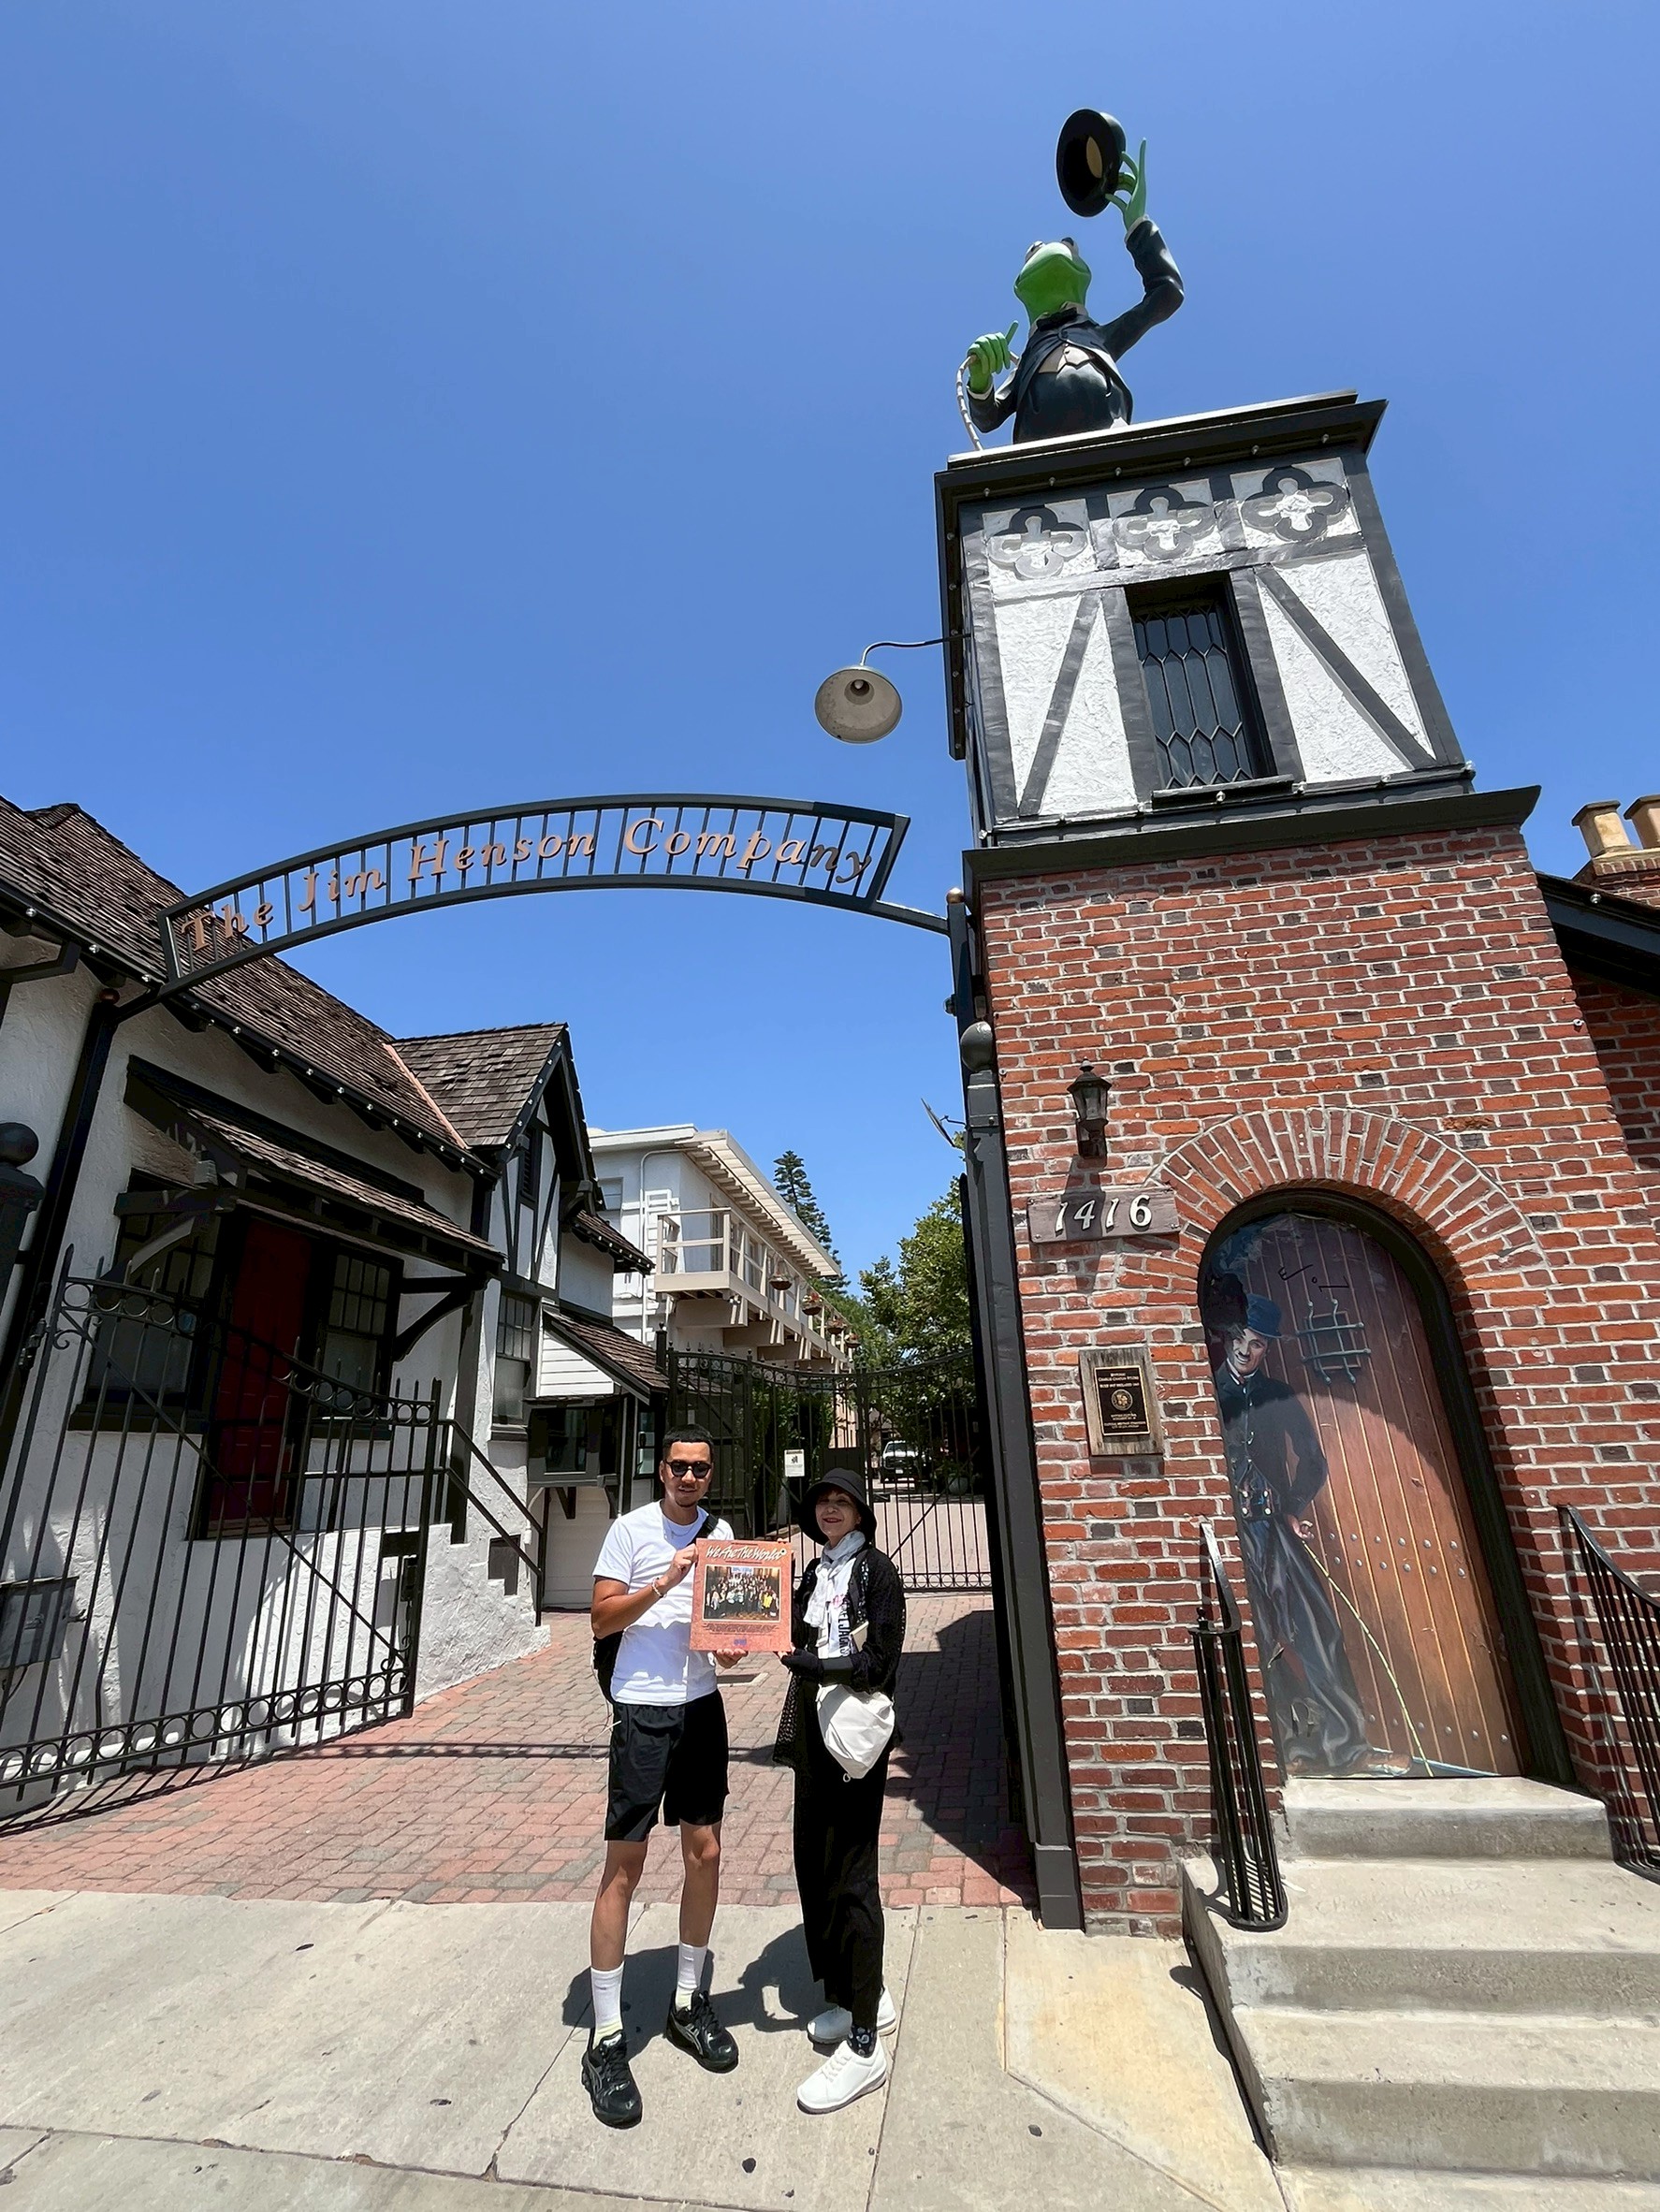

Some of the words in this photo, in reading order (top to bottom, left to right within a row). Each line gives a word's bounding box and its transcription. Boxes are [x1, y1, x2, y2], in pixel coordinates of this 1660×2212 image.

[181, 902, 274, 952] The
[299, 868, 386, 911] Jim
[408, 833, 595, 880] Henson
[625, 818, 872, 883] Company
[1055, 1194, 1152, 1232] 1416
[706, 1545, 721, 1558] We
[718, 1545, 736, 1560] Are
[735, 1545, 753, 1559] The
[751, 1546, 787, 1561] World
